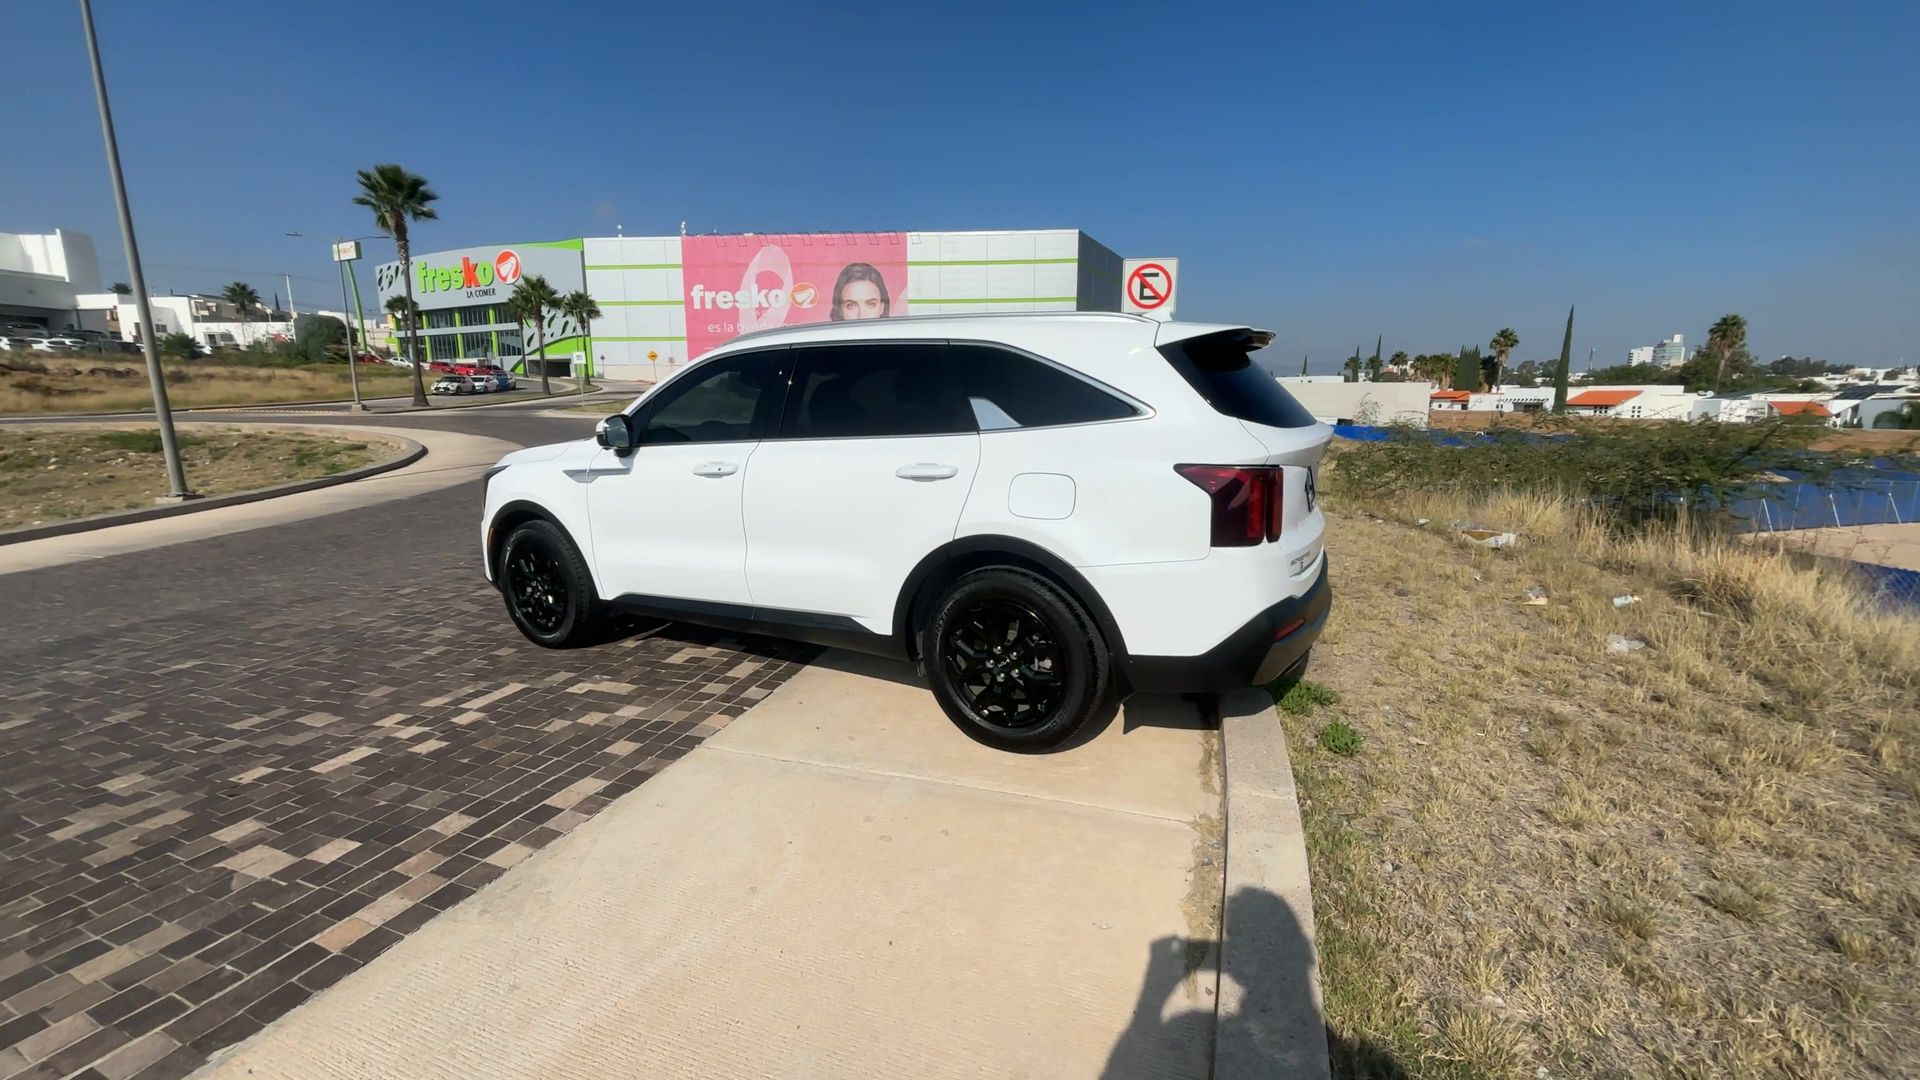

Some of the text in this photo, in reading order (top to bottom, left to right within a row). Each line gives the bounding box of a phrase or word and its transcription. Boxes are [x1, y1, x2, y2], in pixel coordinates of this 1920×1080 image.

[416, 256, 494, 293] fresko
[466, 287, 497, 298] LA COMER
[690, 284, 787, 310] fresko
[707, 323, 721, 333] es
[724, 321, 735, 333] la
